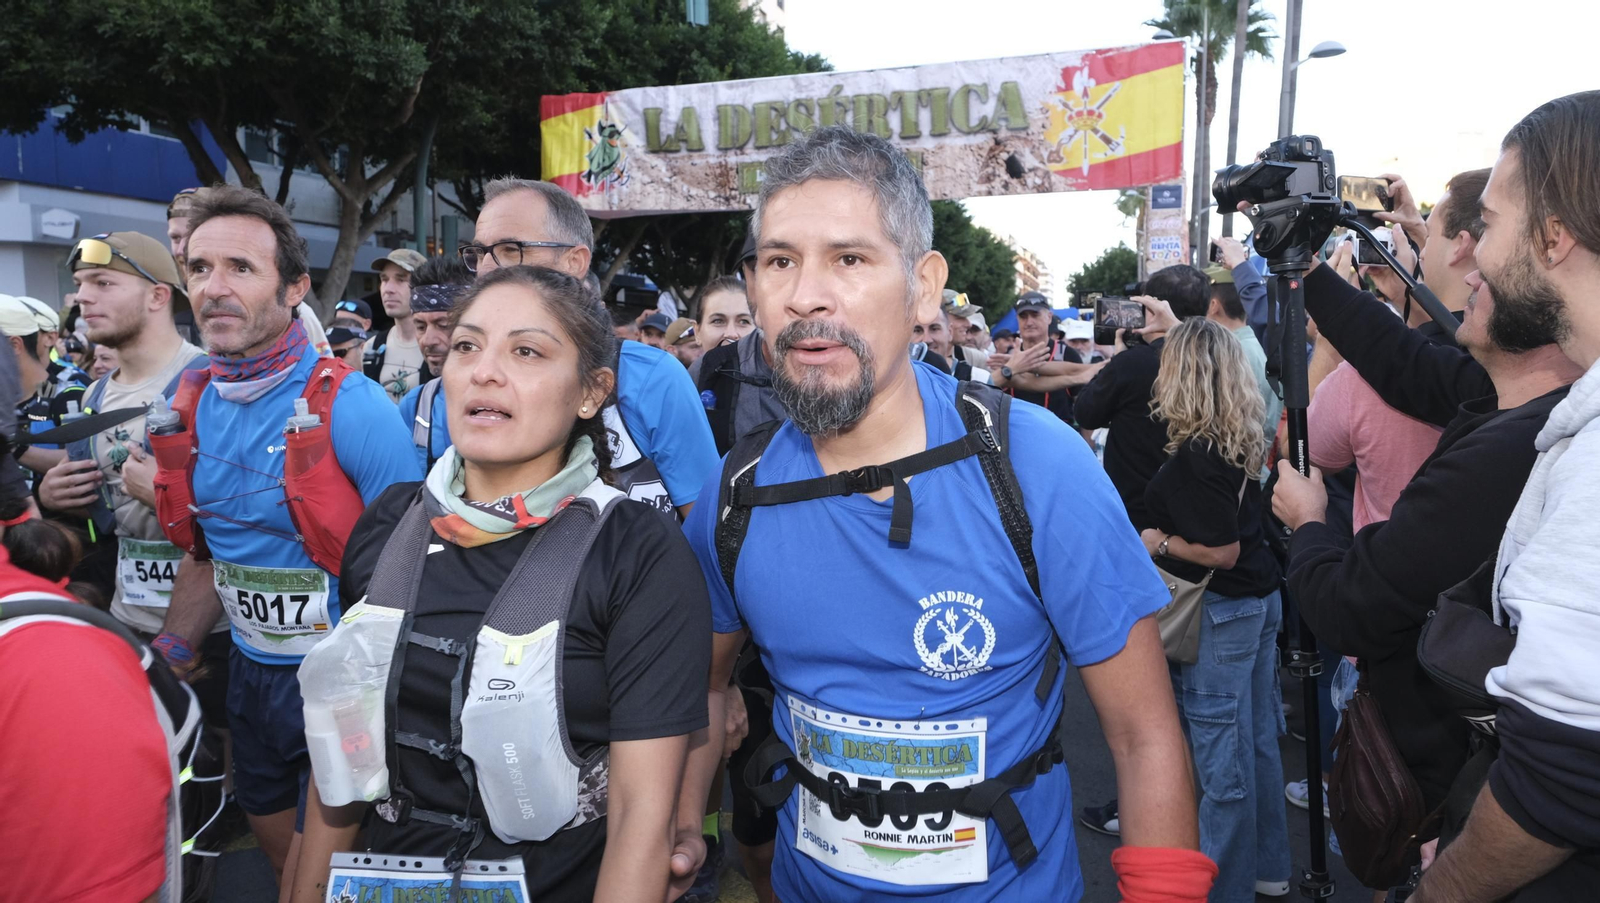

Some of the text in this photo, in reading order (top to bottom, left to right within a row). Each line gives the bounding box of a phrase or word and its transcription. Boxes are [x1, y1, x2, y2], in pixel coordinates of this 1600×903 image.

[643, 81, 1029, 153] LA DESÉRTICA
[1151, 242, 1180, 250] RENTA
[237, 590, 309, 625] 5017
[918, 590, 984, 610] BANDERA
[811, 730, 973, 765] LA DESÉRTICA
[502, 742, 535, 820] SOFT FLASK 500
[864, 830, 953, 844] RONNIE MARTIN
[358, 883, 518, 903] LA DESÉTICA
